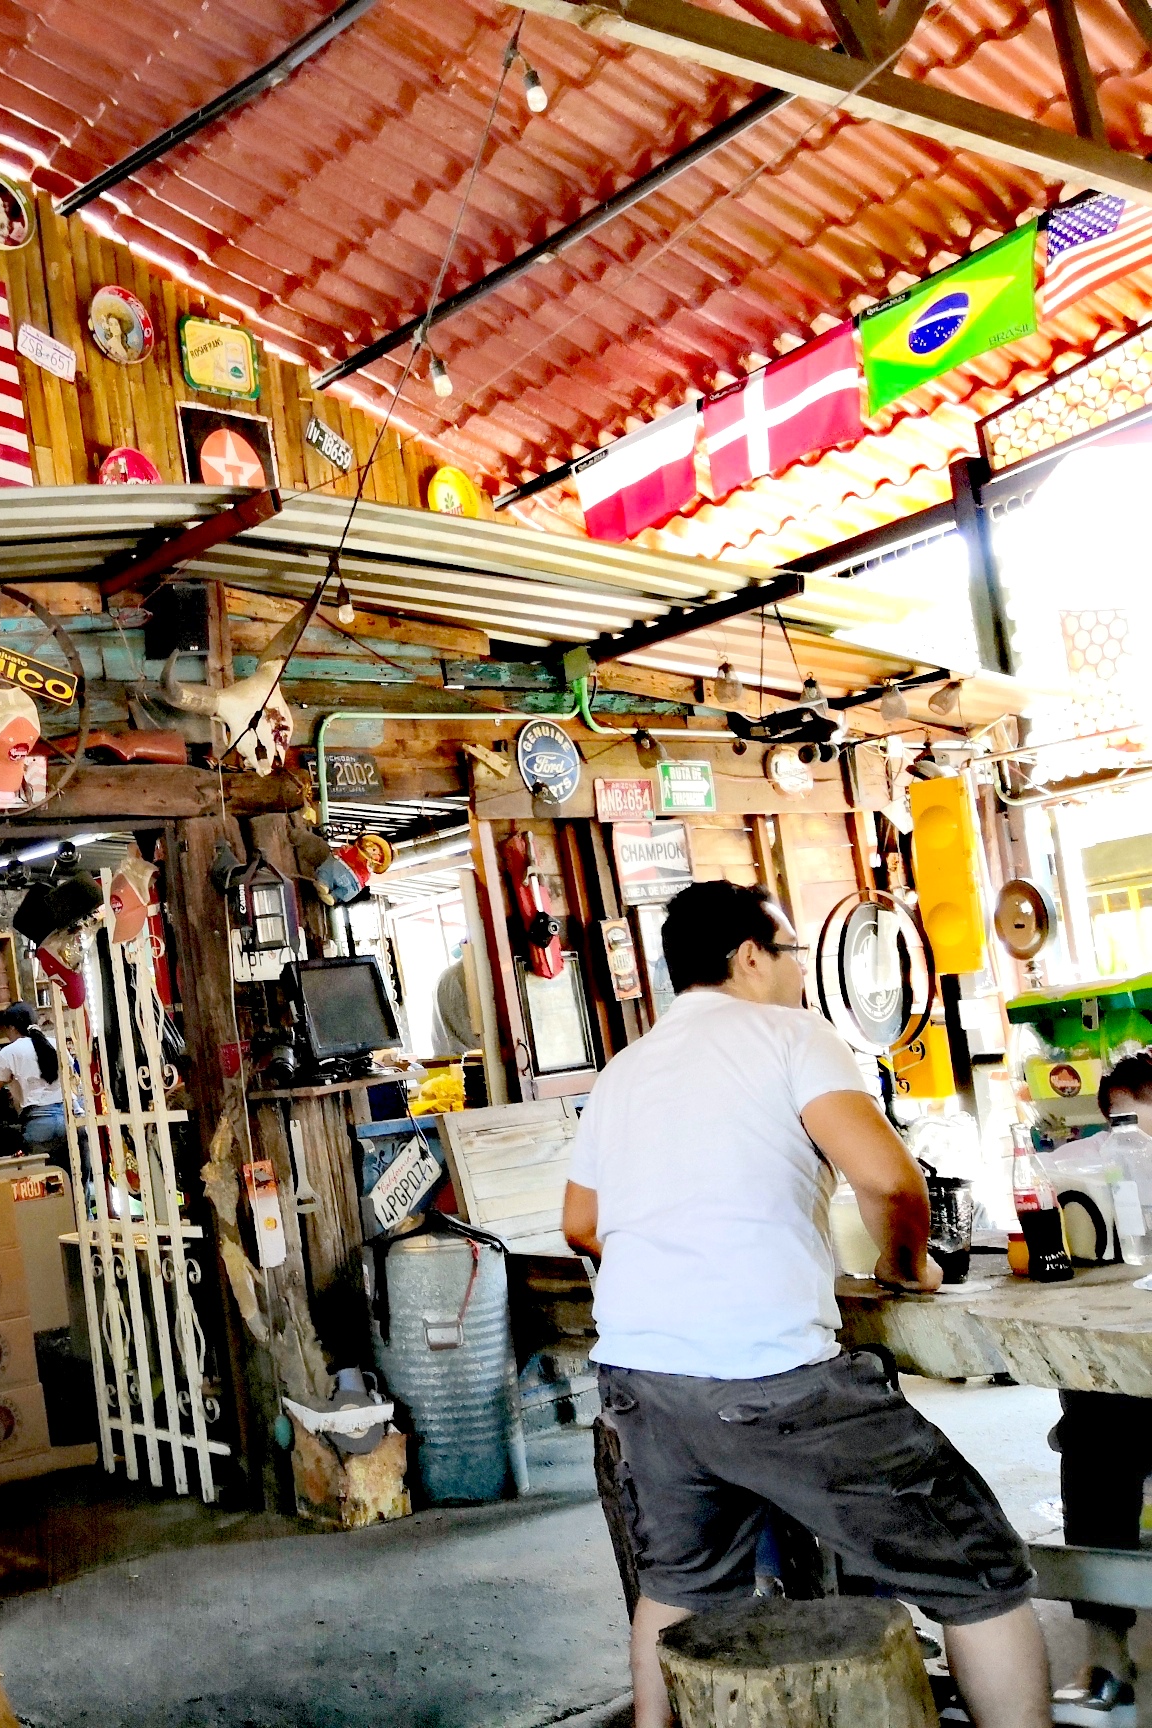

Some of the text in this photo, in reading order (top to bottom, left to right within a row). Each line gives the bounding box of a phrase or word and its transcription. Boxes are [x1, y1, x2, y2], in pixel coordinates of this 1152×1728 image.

[988, 324, 1031, 346] BRASIL
[523, 726, 571, 752] GENUINE
[334, 762, 379, 785] 2002
[534, 755, 565, 774] Ford
[620, 842, 685, 863] CHAMPION
